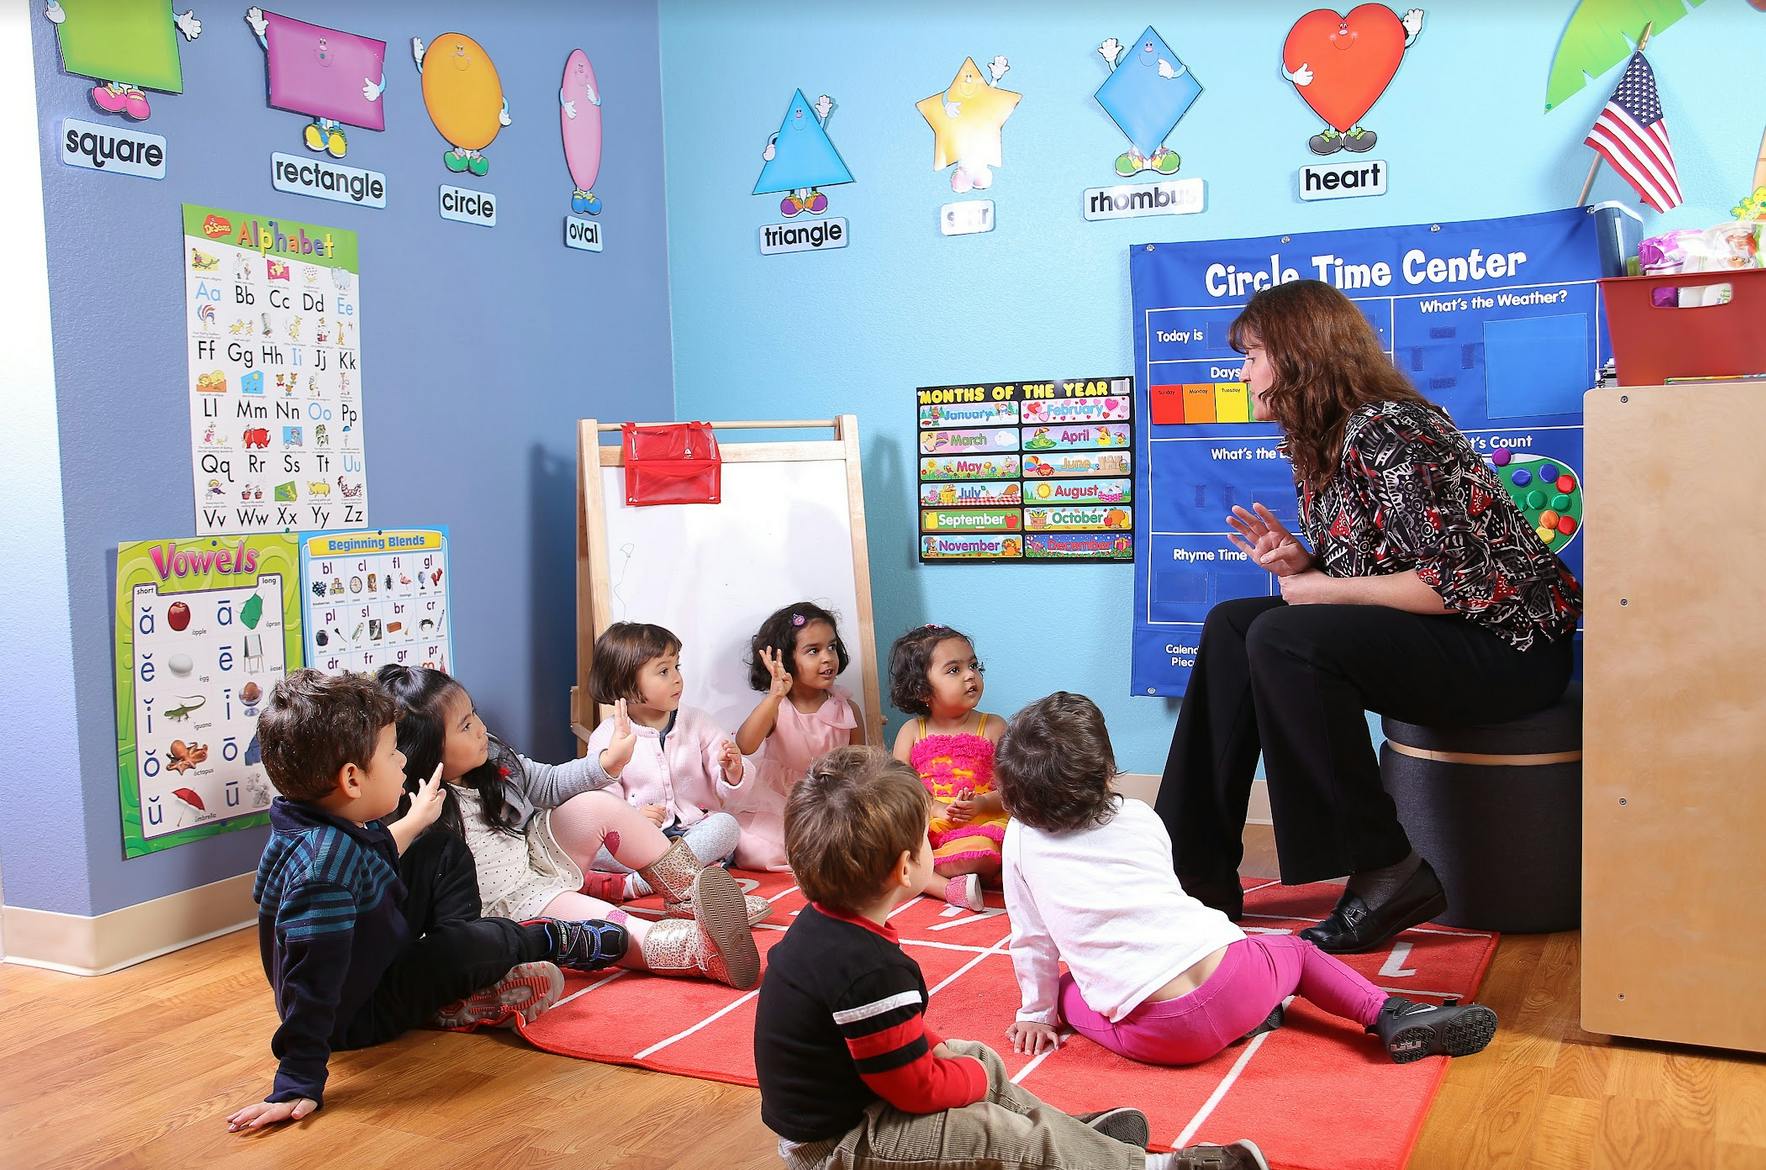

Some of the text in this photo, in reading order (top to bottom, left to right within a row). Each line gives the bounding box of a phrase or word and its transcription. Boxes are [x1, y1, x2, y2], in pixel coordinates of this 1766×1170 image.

[66, 127, 164, 168] square
[274, 158, 385, 203] rectangle
[1305, 164, 1382, 193] heart
[442, 190, 495, 220] circle
[1091, 186, 1186, 214] rhombu
[238, 220, 334, 258] Alphabet
[569, 222, 599, 245] oval
[764, 220, 842, 248] triangle
[1205, 247, 1527, 298] Circle Time Center
[196, 281, 353, 316] Aa Bb Cc Dd Ee
[1420, 289, 1568, 314] What's the Weather?
[1157, 328, 1204, 344] Today is
[198, 340, 215, 360] Ff
[228, 342, 254, 368] Gg
[262, 345, 284, 365] Hh
[314, 350, 326, 370] Jj
[339, 352, 356, 370] Kk
[1210, 366, 1241, 381] Days
[918, 381, 1108, 405] MONTHS OF THE YEAR
[204, 398, 358, 427] Ll Mm Nn Oo Pp
[942, 409, 992, 422] January
[1046, 403, 1104, 418] February
[950, 433, 988, 446] March
[1061, 430, 1090, 445] April
[1490, 434, 1532, 449] Count
[1211, 448, 1252, 460] What's
[1256, 447, 1277, 460] the
[201, 454, 361, 482] Qq Rr Ss Tt Uu
[956, 460, 983, 474] May
[1062, 456, 1091, 470] June
[958, 486, 982, 500] July
[1054, 484, 1099, 500] August
[203, 505, 364, 529] Vv Ww Xx Yy Zz
[938, 513, 1004, 528] September
[1052, 511, 1104, 525] October
[328, 535, 425, 551] Beginning Blends
[938, 540, 1000, 552] November
[1047, 539, 1112, 552] December
[148, 540, 260, 581] Vowels
[322, 554, 433, 574] bl cl fl gl
[1173, 548, 1248, 565] Rhyme Time
[262, 577, 277, 586] long
[136, 587, 154, 596] short
[326, 601, 436, 625] pl sl br cr
[328, 645, 438, 670] dr fr gr pr
